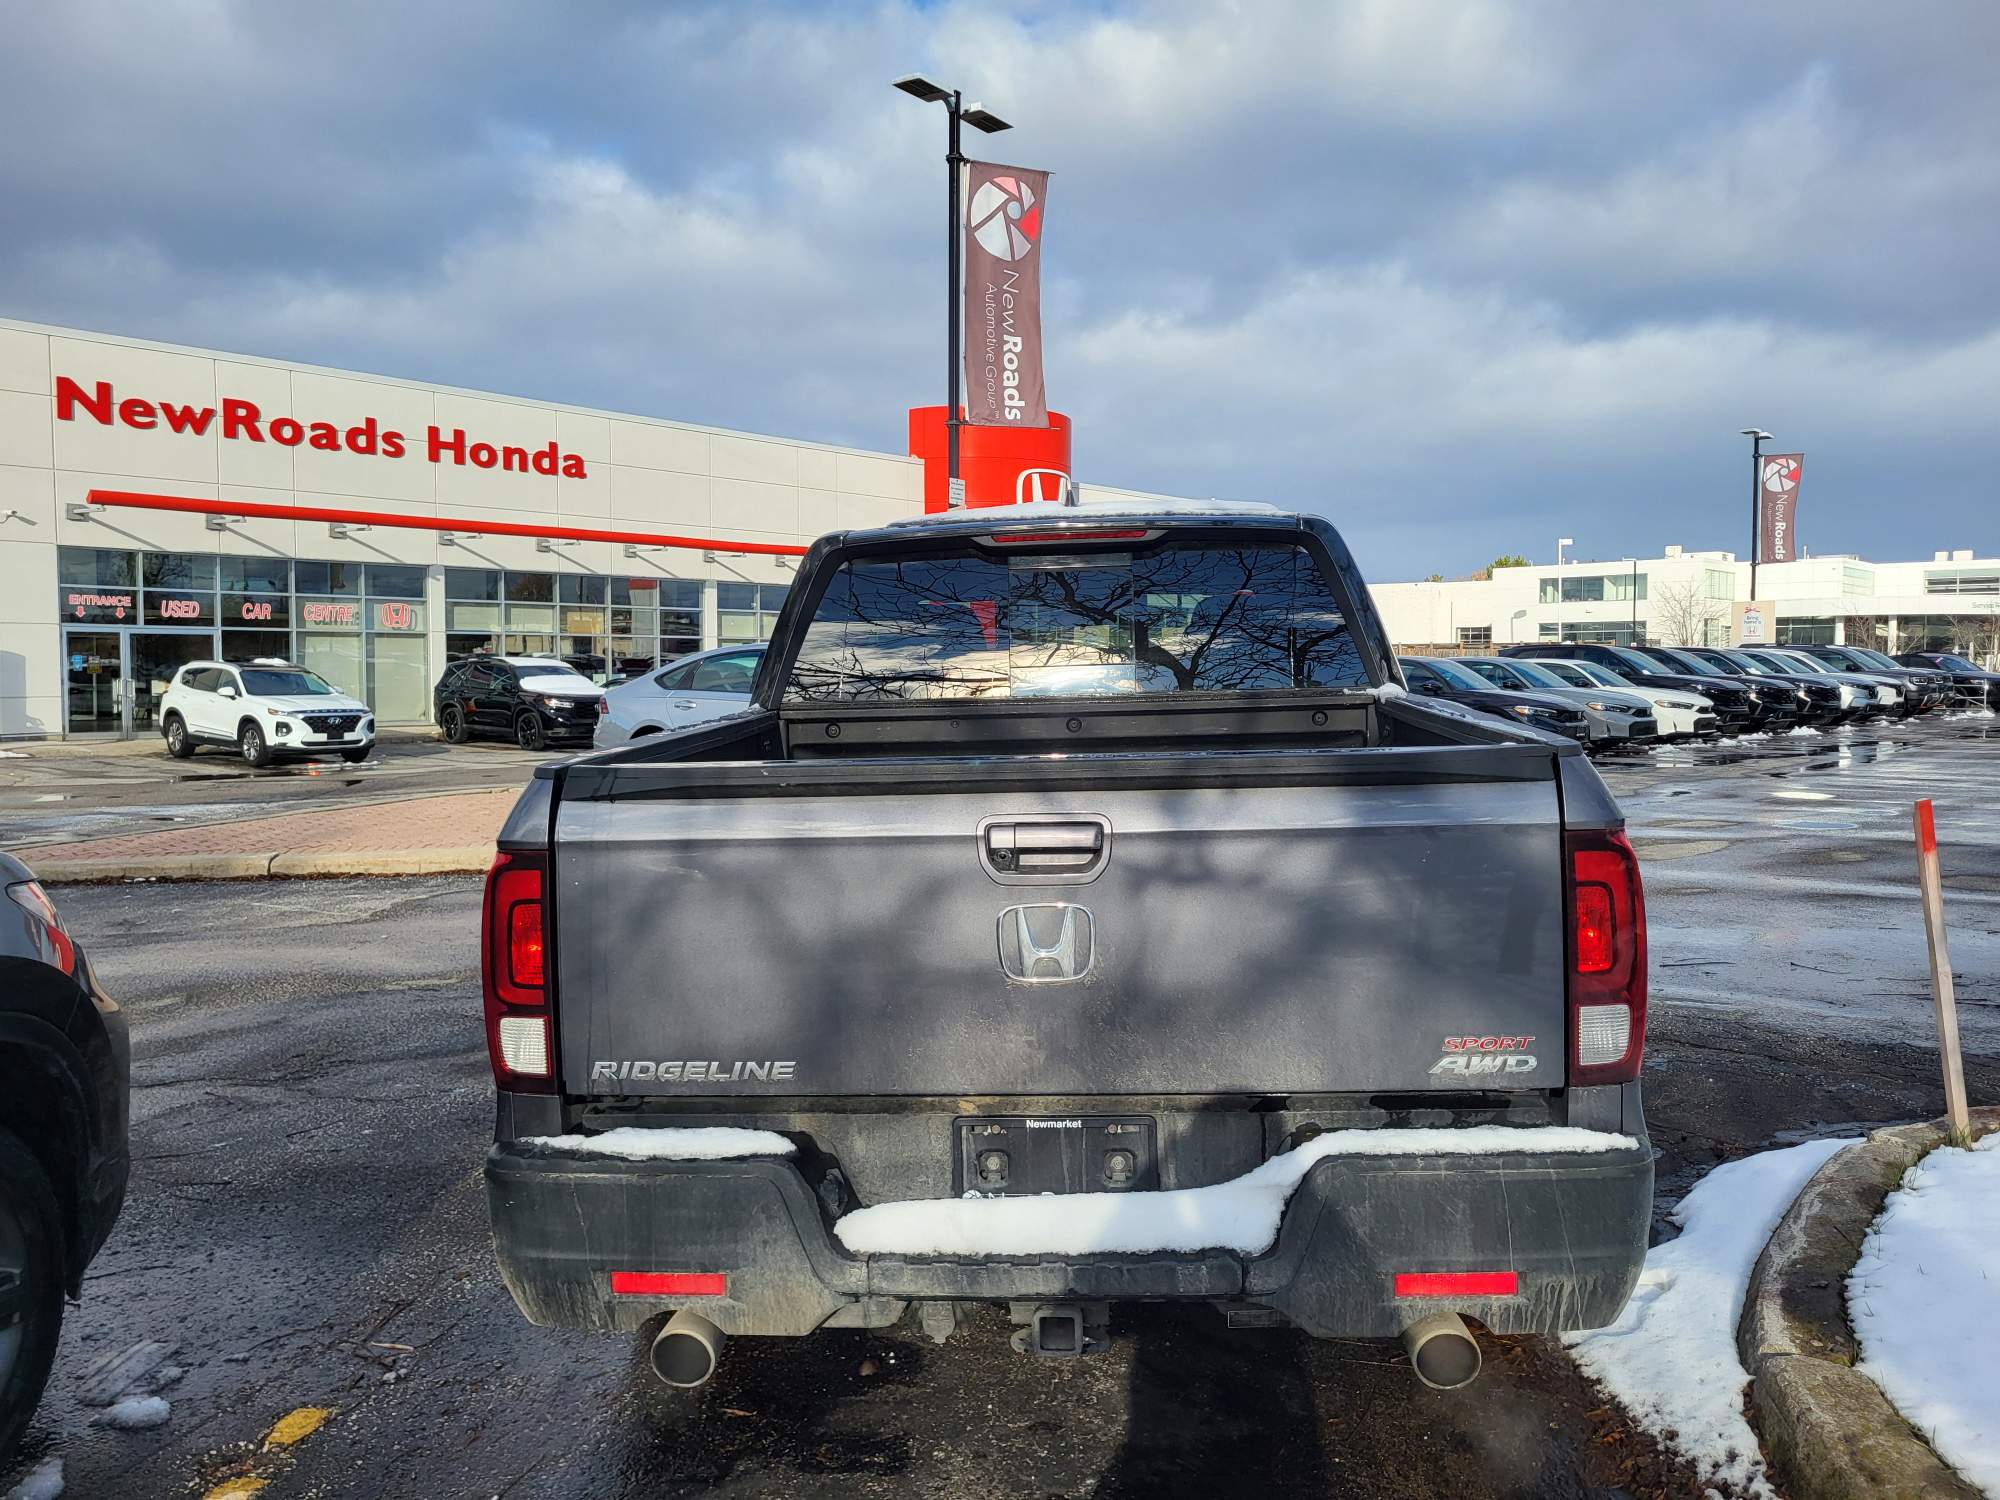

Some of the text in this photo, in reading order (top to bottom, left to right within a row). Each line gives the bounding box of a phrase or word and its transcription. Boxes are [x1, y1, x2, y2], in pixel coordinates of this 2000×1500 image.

[985, 282, 998, 362] Automotive
[1002, 269, 1026, 420] NewRoads
[56, 376, 587, 479] NewRoads Honda
[1774, 494, 1788, 560] NewRoads
[68, 593, 132, 607] ENTRANCE
[161, 599, 354, 621] USED CAR CENTRE
[1442, 1036, 1536, 1052] SPORT
[591, 1061, 797, 1081] RIDGELINE
[1428, 1055, 1538, 1074] AWD
[1026, 1119, 1082, 1129] Newmarket
